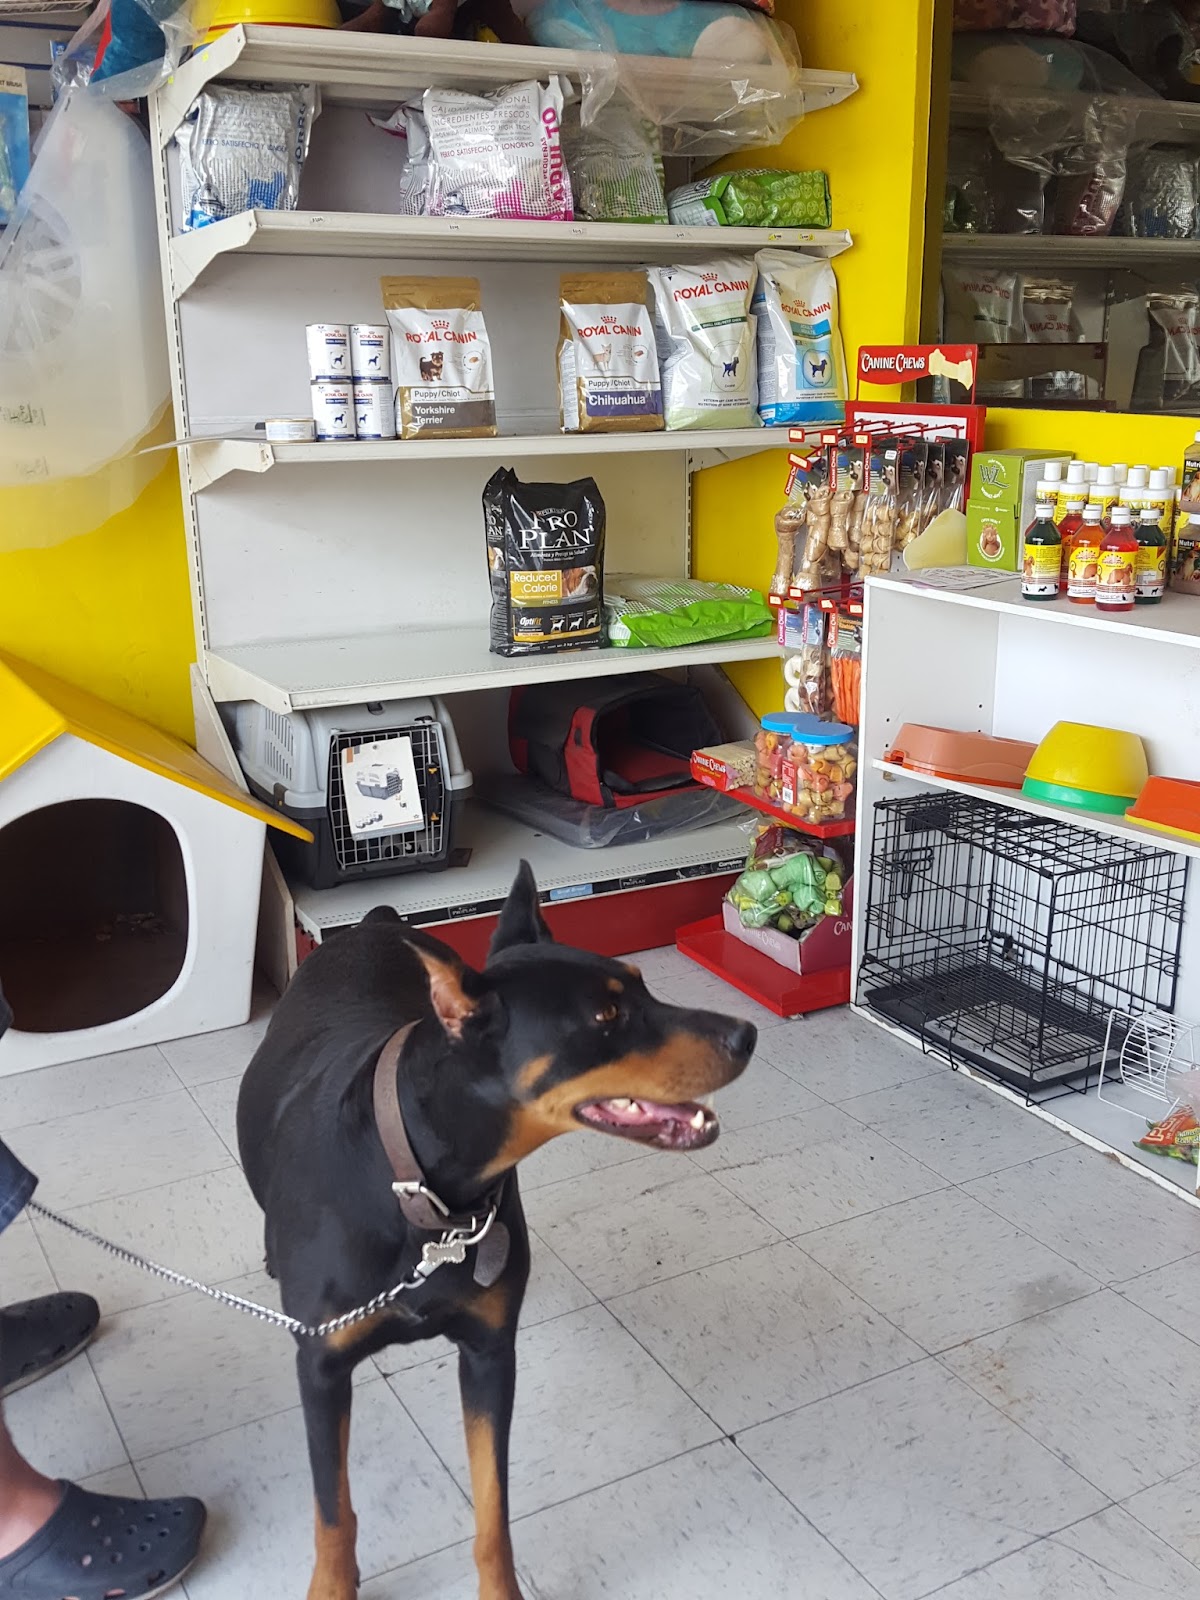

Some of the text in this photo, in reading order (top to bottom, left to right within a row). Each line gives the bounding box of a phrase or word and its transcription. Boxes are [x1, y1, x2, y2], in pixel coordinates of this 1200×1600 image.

[433, 110, 530, 126] INGREDIENTES FRESCOS
[221, 139, 260, 149] SATISFECHO
[457, 145, 494, 156] SATISFECHO
[501, 141, 535, 151] LONGEVO
[673, 280, 750, 302] ROYAL CANIN
[781, 302, 832, 317] ROYAL CANIN
[405, 331, 478, 344] ROYAL CANIN
[577, 325, 642, 338] ROYAL CANIN
[861, 353, 926, 372] CANINE CHEWS
[588, 394, 646, 406] Chihuahua
[414, 406, 456, 415] Yorkshire
[415, 416, 444, 425] Terrier
[519, 528, 590, 549] PLAN
[514, 572, 558, 583] Reduced
[523, 583, 558, 593] Calorie
[833, 921, 852, 935] CAN
